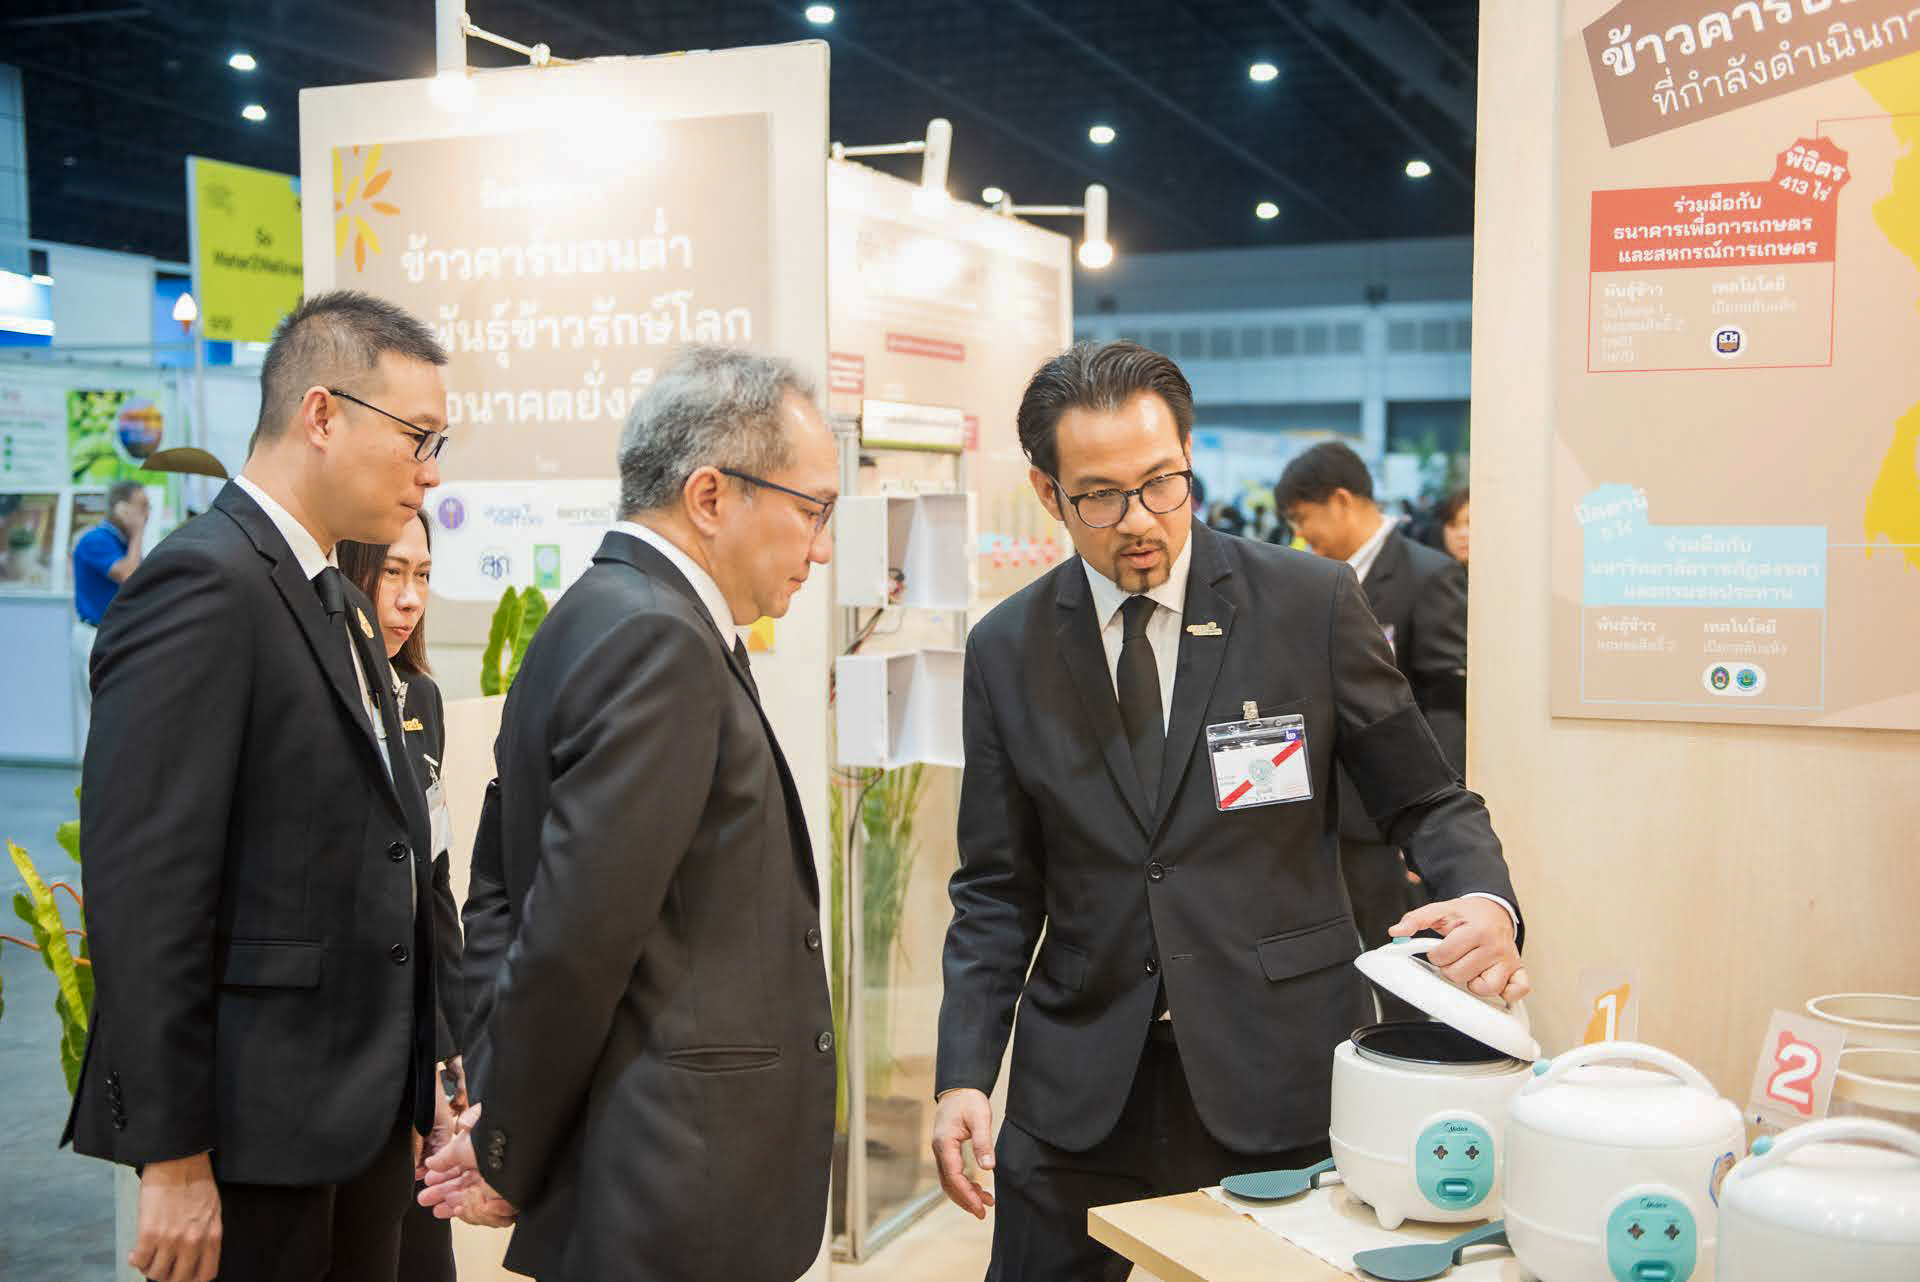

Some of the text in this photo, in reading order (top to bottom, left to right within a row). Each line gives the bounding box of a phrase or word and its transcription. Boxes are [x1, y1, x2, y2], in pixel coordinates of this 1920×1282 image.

[1778, 176, 1808, 195] 413
[1674, 192, 1762, 214] ร่วมมือกับ
[1613, 213, 1813, 240] ธนาคารเพื่อการเกษตร
[1618, 239, 1818, 264] และสหกรณ์การเกษตร
[1769, 1041, 1820, 1106] 2
